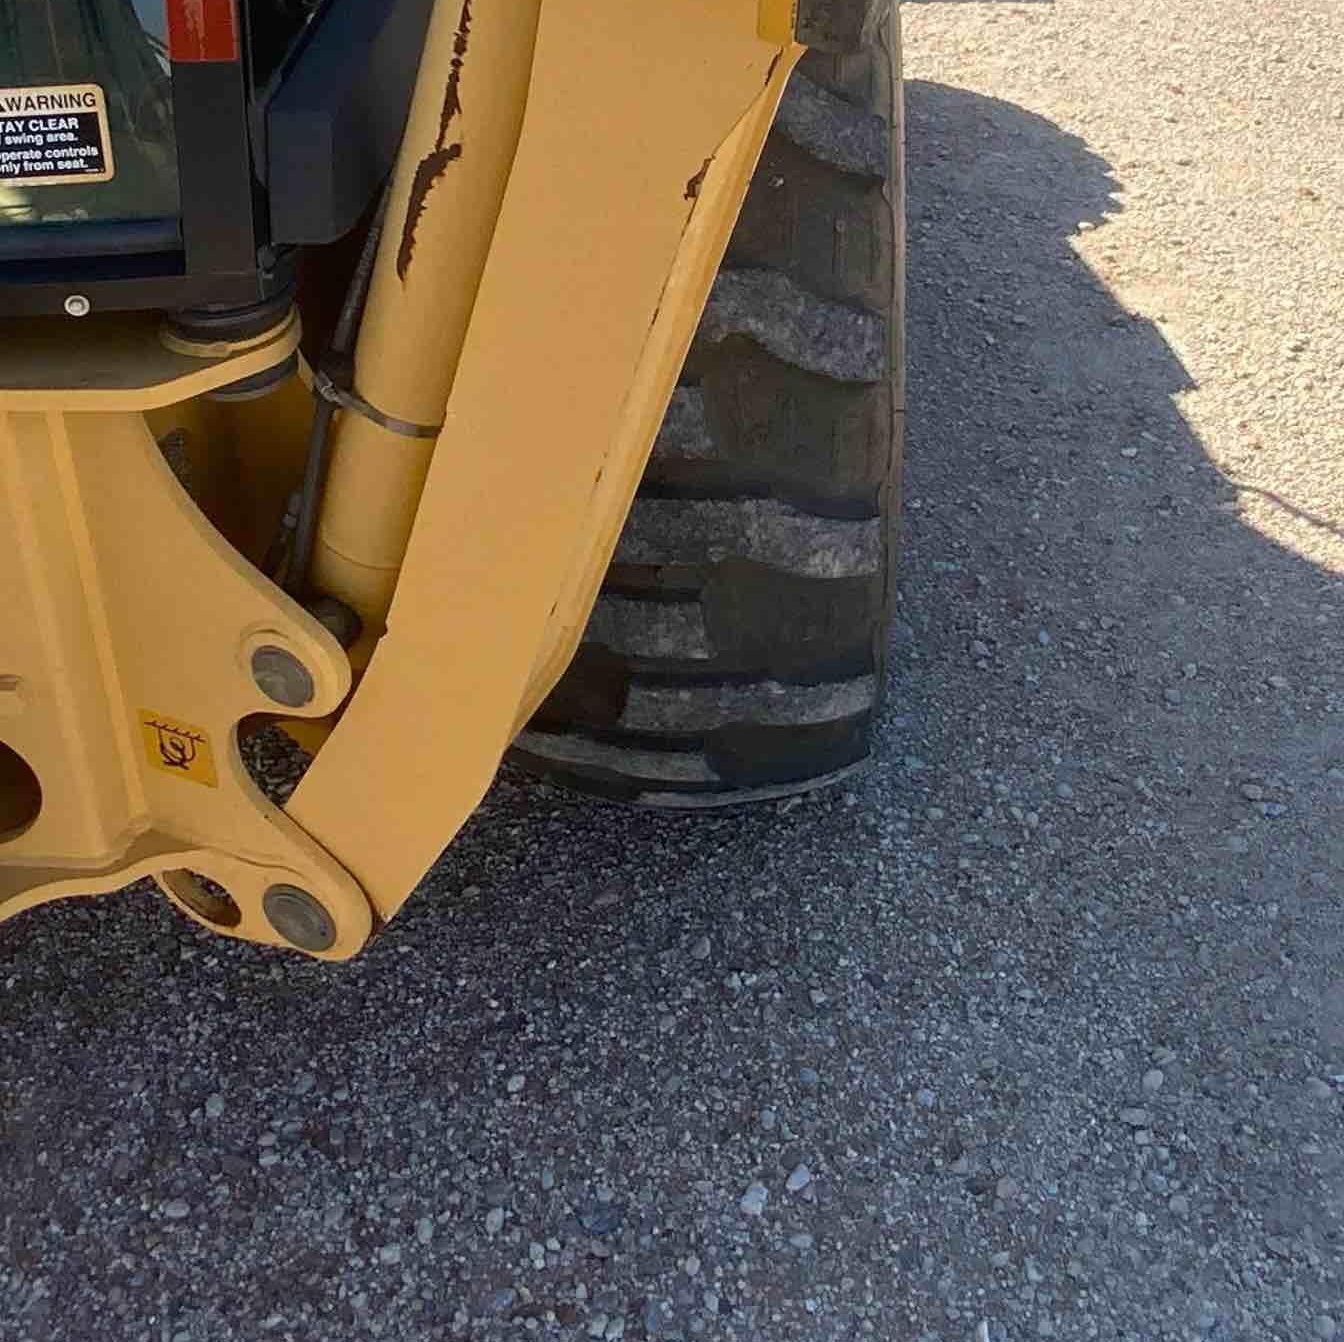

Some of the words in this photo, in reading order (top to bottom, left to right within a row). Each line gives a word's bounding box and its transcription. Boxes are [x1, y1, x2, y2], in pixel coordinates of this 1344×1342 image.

[4, 92, 96, 112] WARNING
[28, 117, 79, 131] CLEAR
[4, 132, 43, 146] swing
[46, 132, 78, 143] area.
[45, 145, 98, 157] controls
[23, 160, 54, 171] from
[57, 158, 88, 170] seat.
